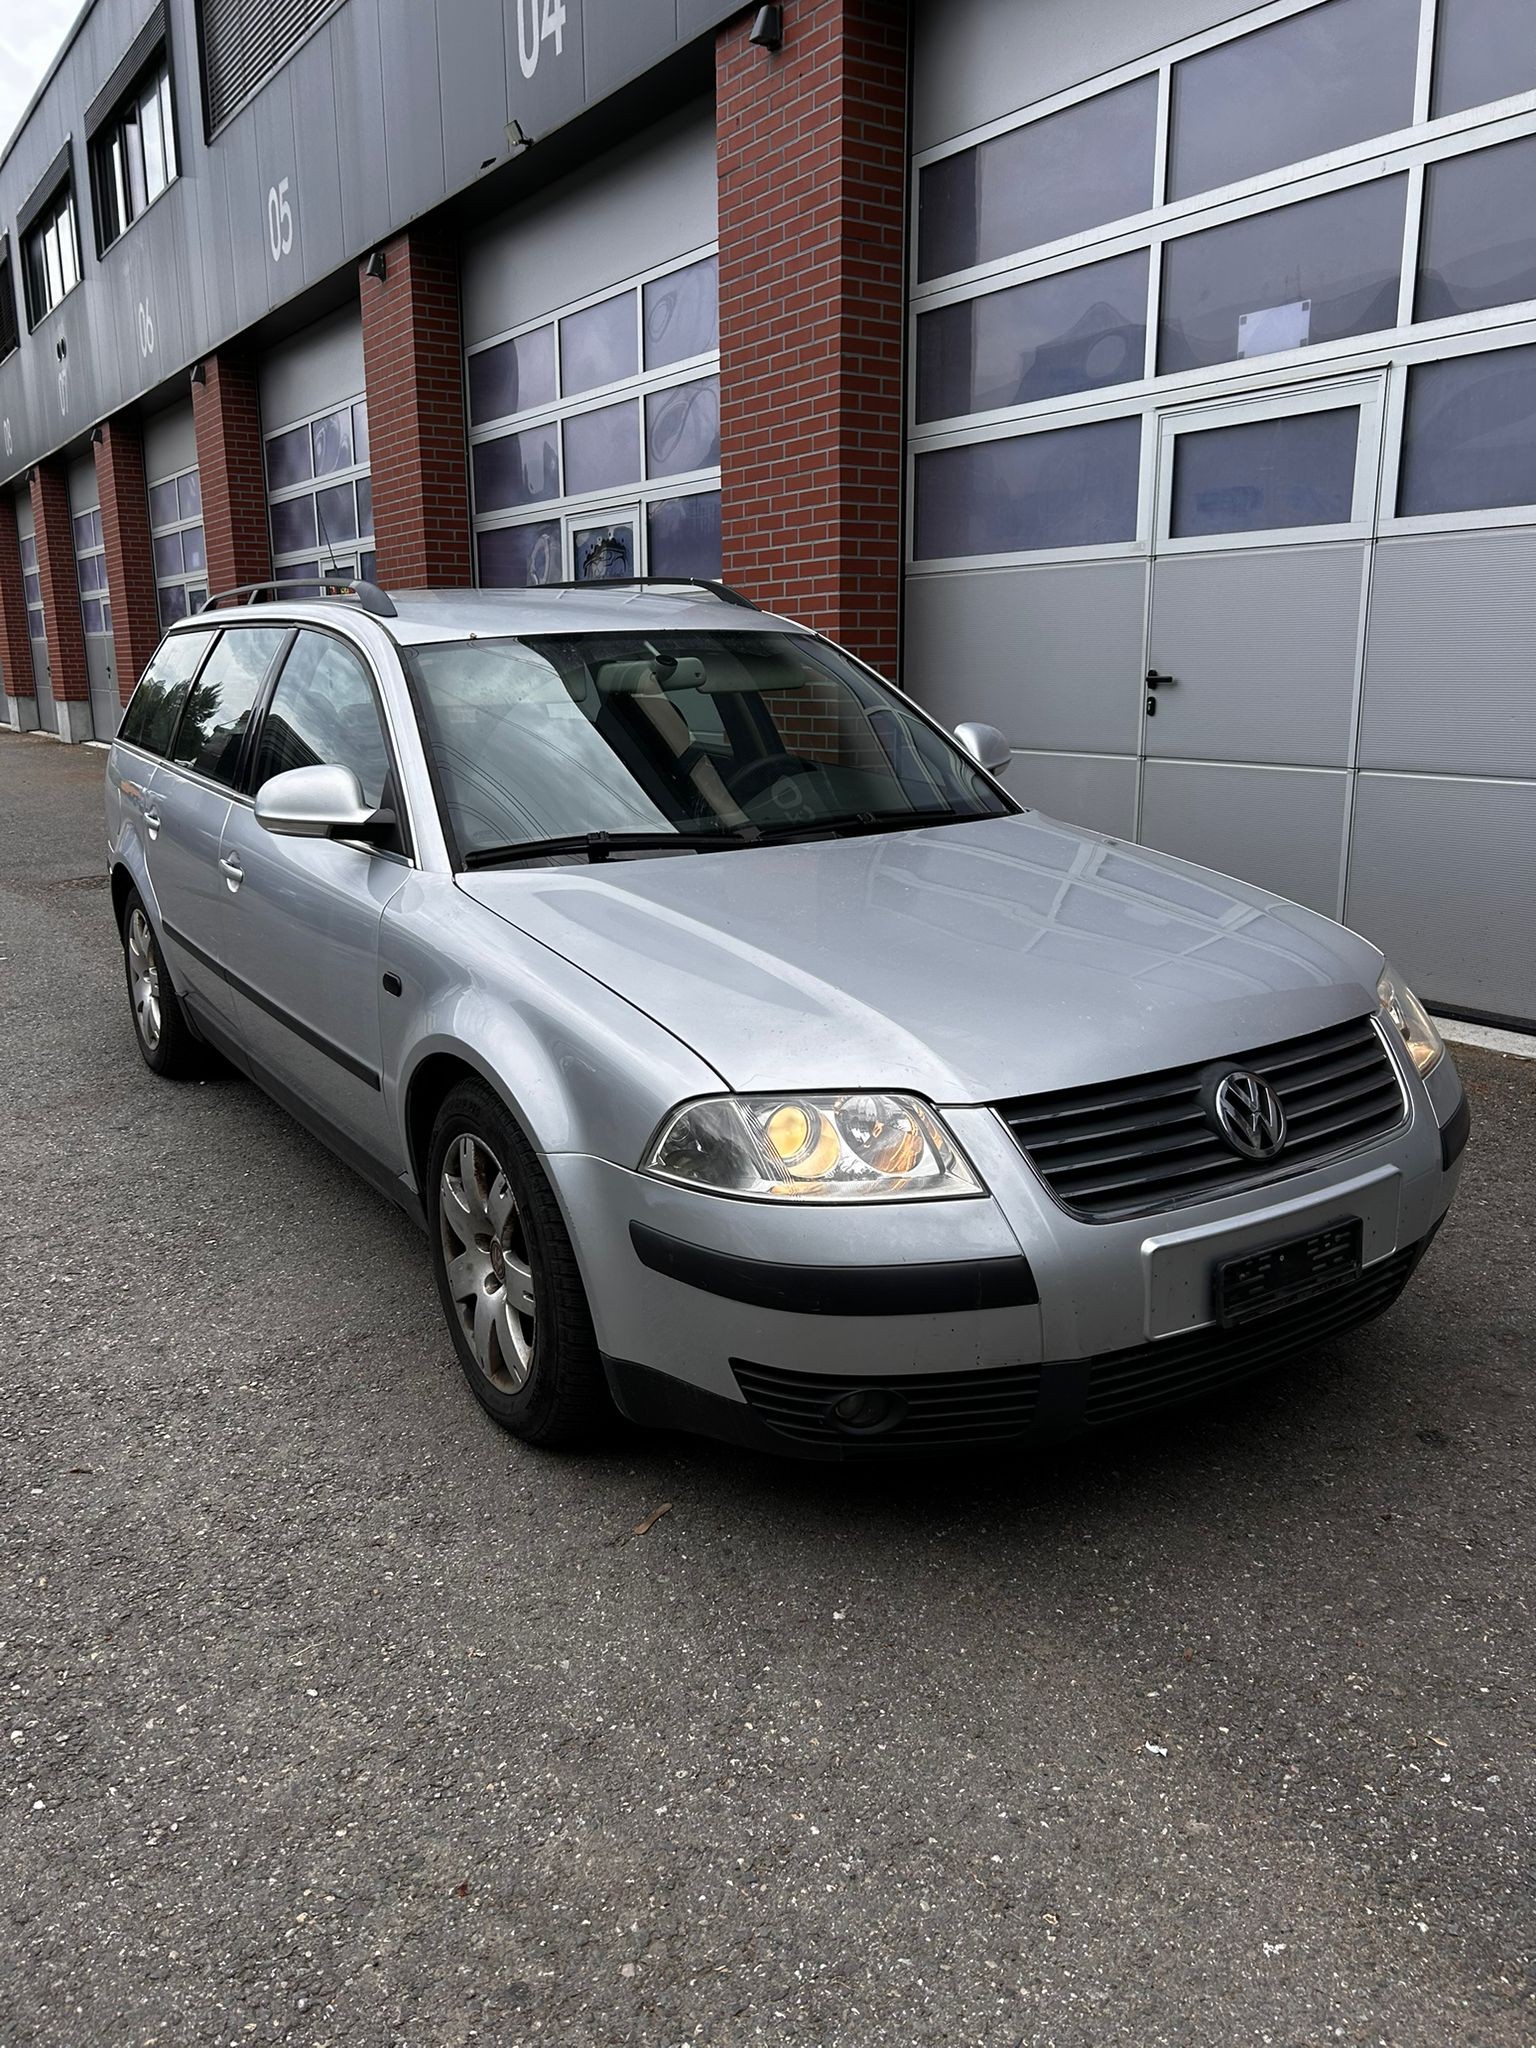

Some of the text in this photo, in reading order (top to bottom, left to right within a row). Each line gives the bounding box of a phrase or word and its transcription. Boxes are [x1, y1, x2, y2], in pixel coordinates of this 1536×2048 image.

[268, 177, 293, 262] 05
[138, 298, 154, 357] 06
[1216, 1071, 1286, 1159] VW
